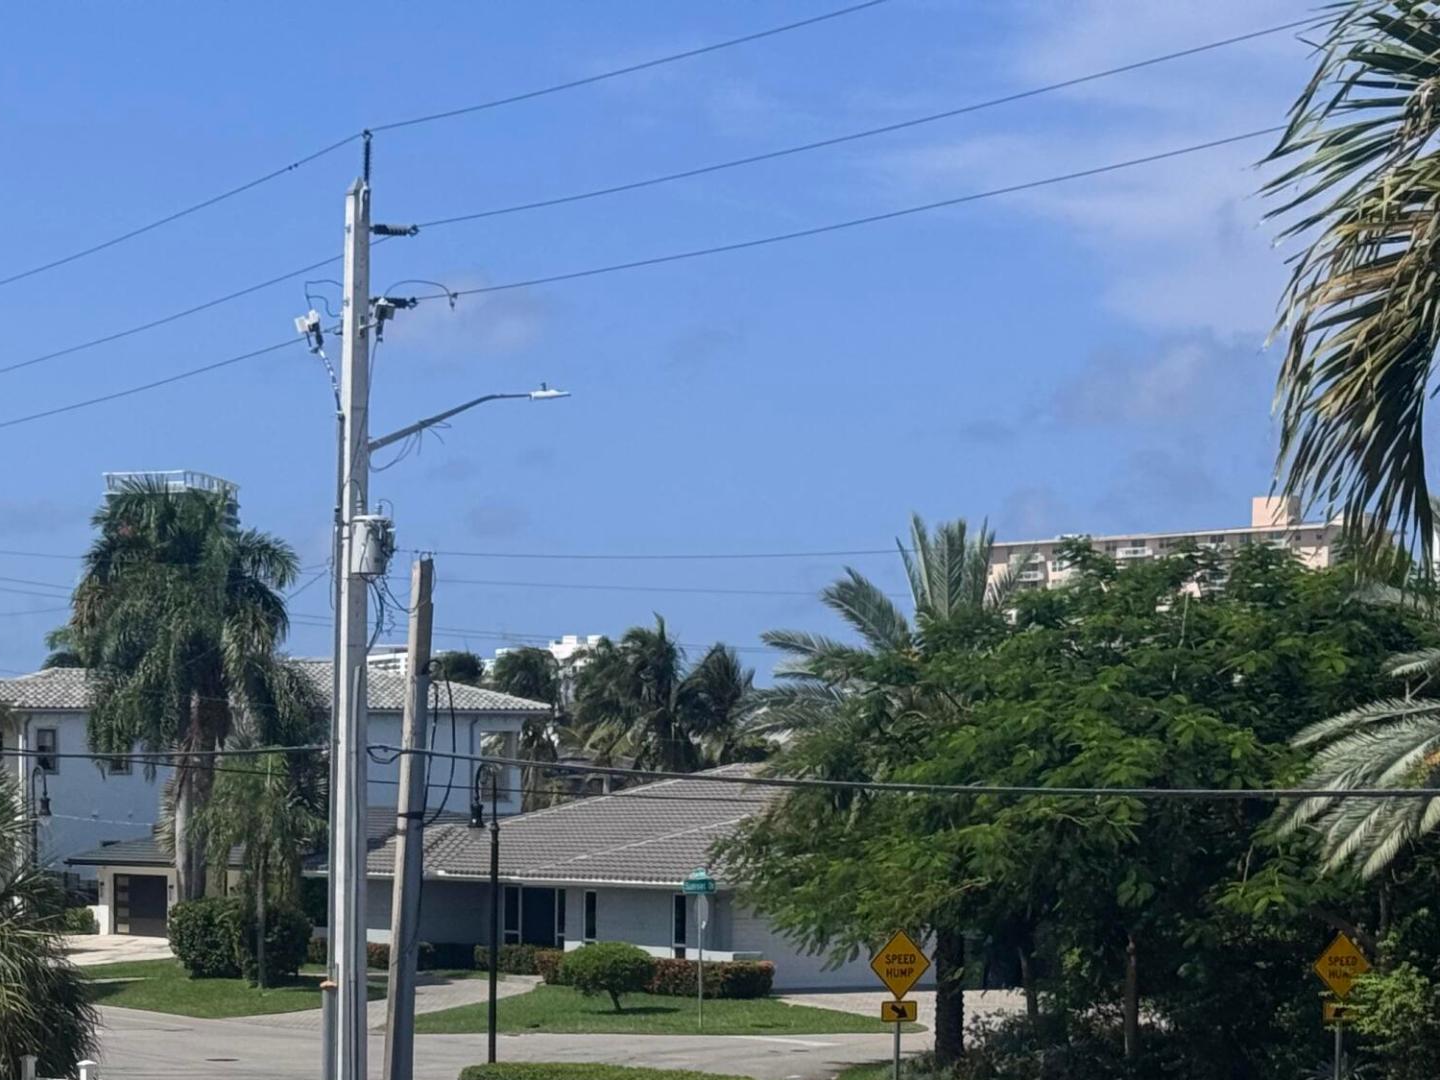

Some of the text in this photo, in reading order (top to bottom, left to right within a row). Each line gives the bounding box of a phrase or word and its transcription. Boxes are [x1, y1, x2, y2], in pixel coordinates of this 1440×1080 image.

[885, 953, 916, 965] SPEED
[1328, 955, 1358, 967] SPEED
[886, 967, 914, 978] HUMP
